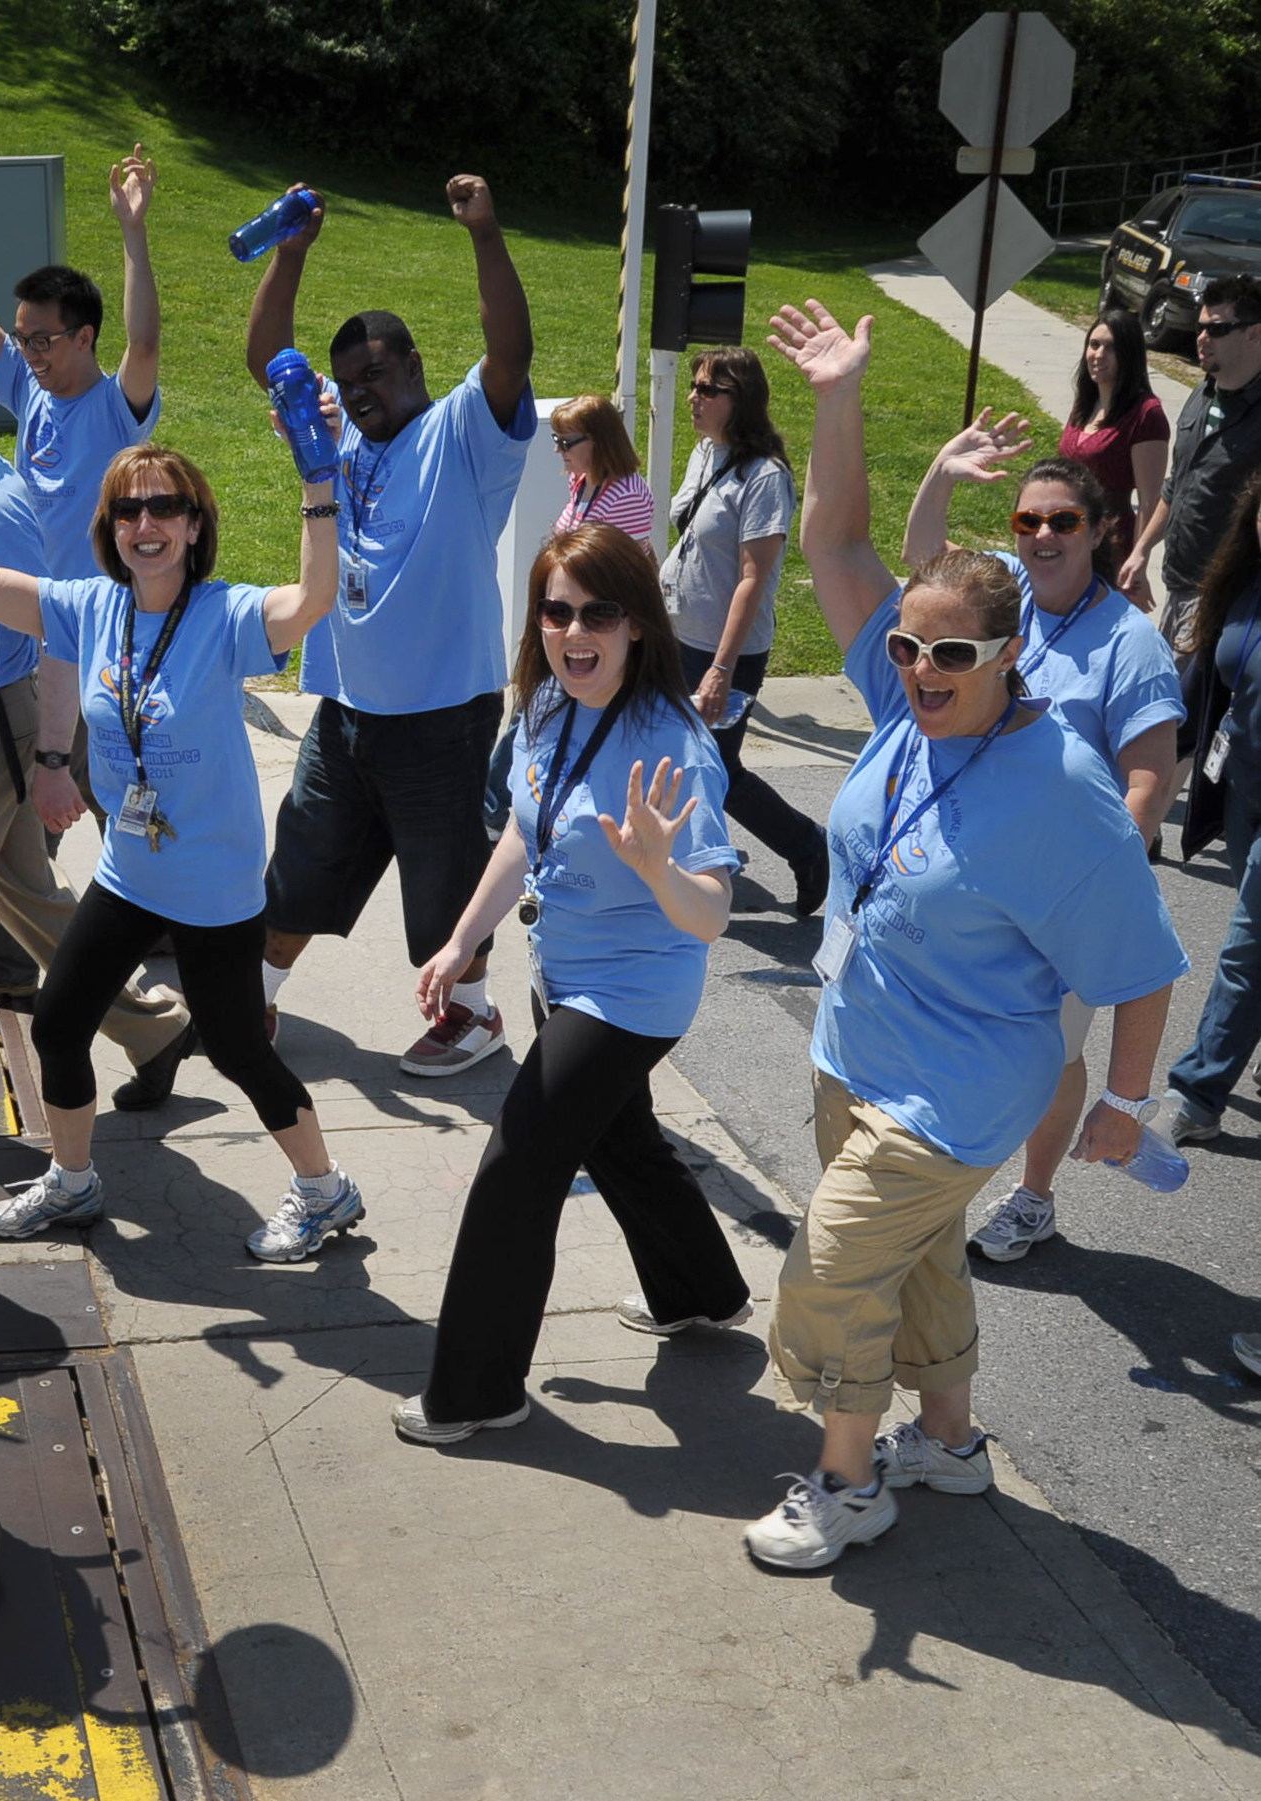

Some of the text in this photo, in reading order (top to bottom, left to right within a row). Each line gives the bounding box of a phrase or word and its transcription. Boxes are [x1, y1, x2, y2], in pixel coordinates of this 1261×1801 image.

[1118, 248, 1153, 272] POLICE
[161, 748, 201, 766] NIH-CC
[148, 766, 175, 779] 2011
[950, 807, 964, 833] HIKE
[865, 906, 888, 937] 2011
[887, 902, 926, 945] NIH-CC
